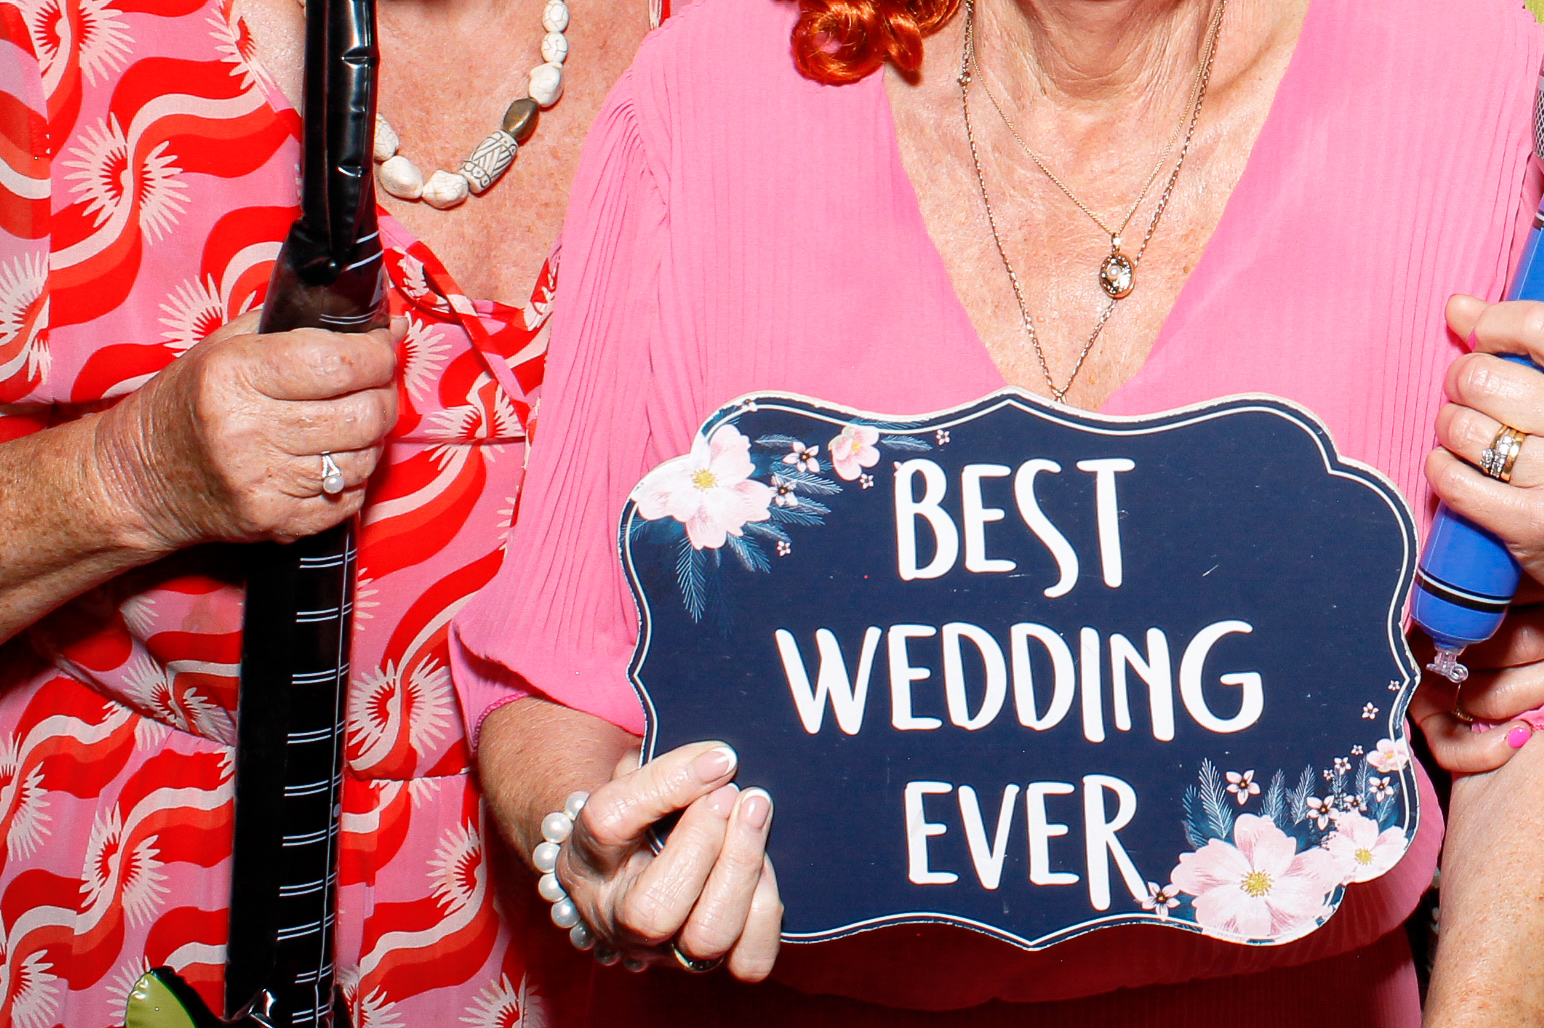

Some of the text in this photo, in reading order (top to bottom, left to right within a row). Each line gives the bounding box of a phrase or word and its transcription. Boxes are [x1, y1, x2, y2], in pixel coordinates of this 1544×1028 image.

[893, 458, 1135, 598] BEST
[775, 621, 1264, 743] WEDDING
[904, 774, 1149, 911] EVER
